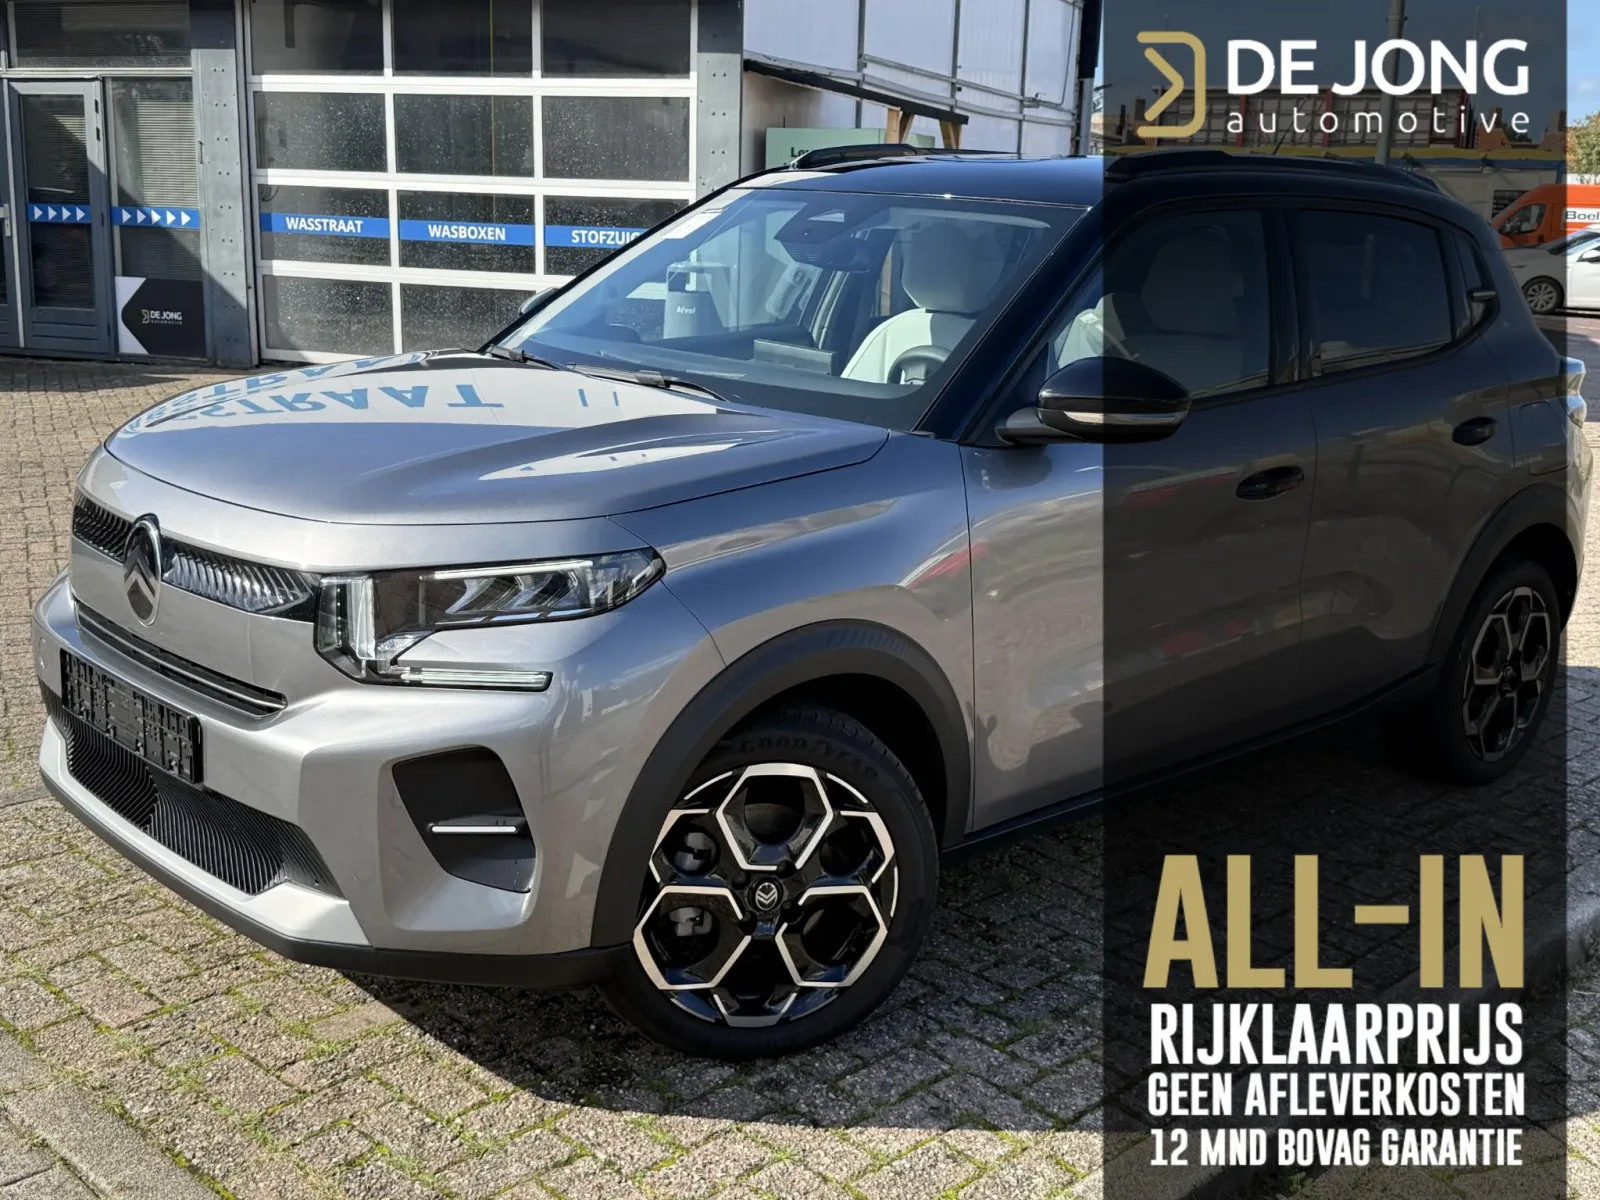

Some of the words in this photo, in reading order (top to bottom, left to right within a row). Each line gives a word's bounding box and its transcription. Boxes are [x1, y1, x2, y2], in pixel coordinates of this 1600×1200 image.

[285, 217, 364, 233] WASSTRAAT
[428, 224, 506, 241] WASBOXEN
[150, 310, 160, 319] DE
[161, 311, 182, 320] JONG
